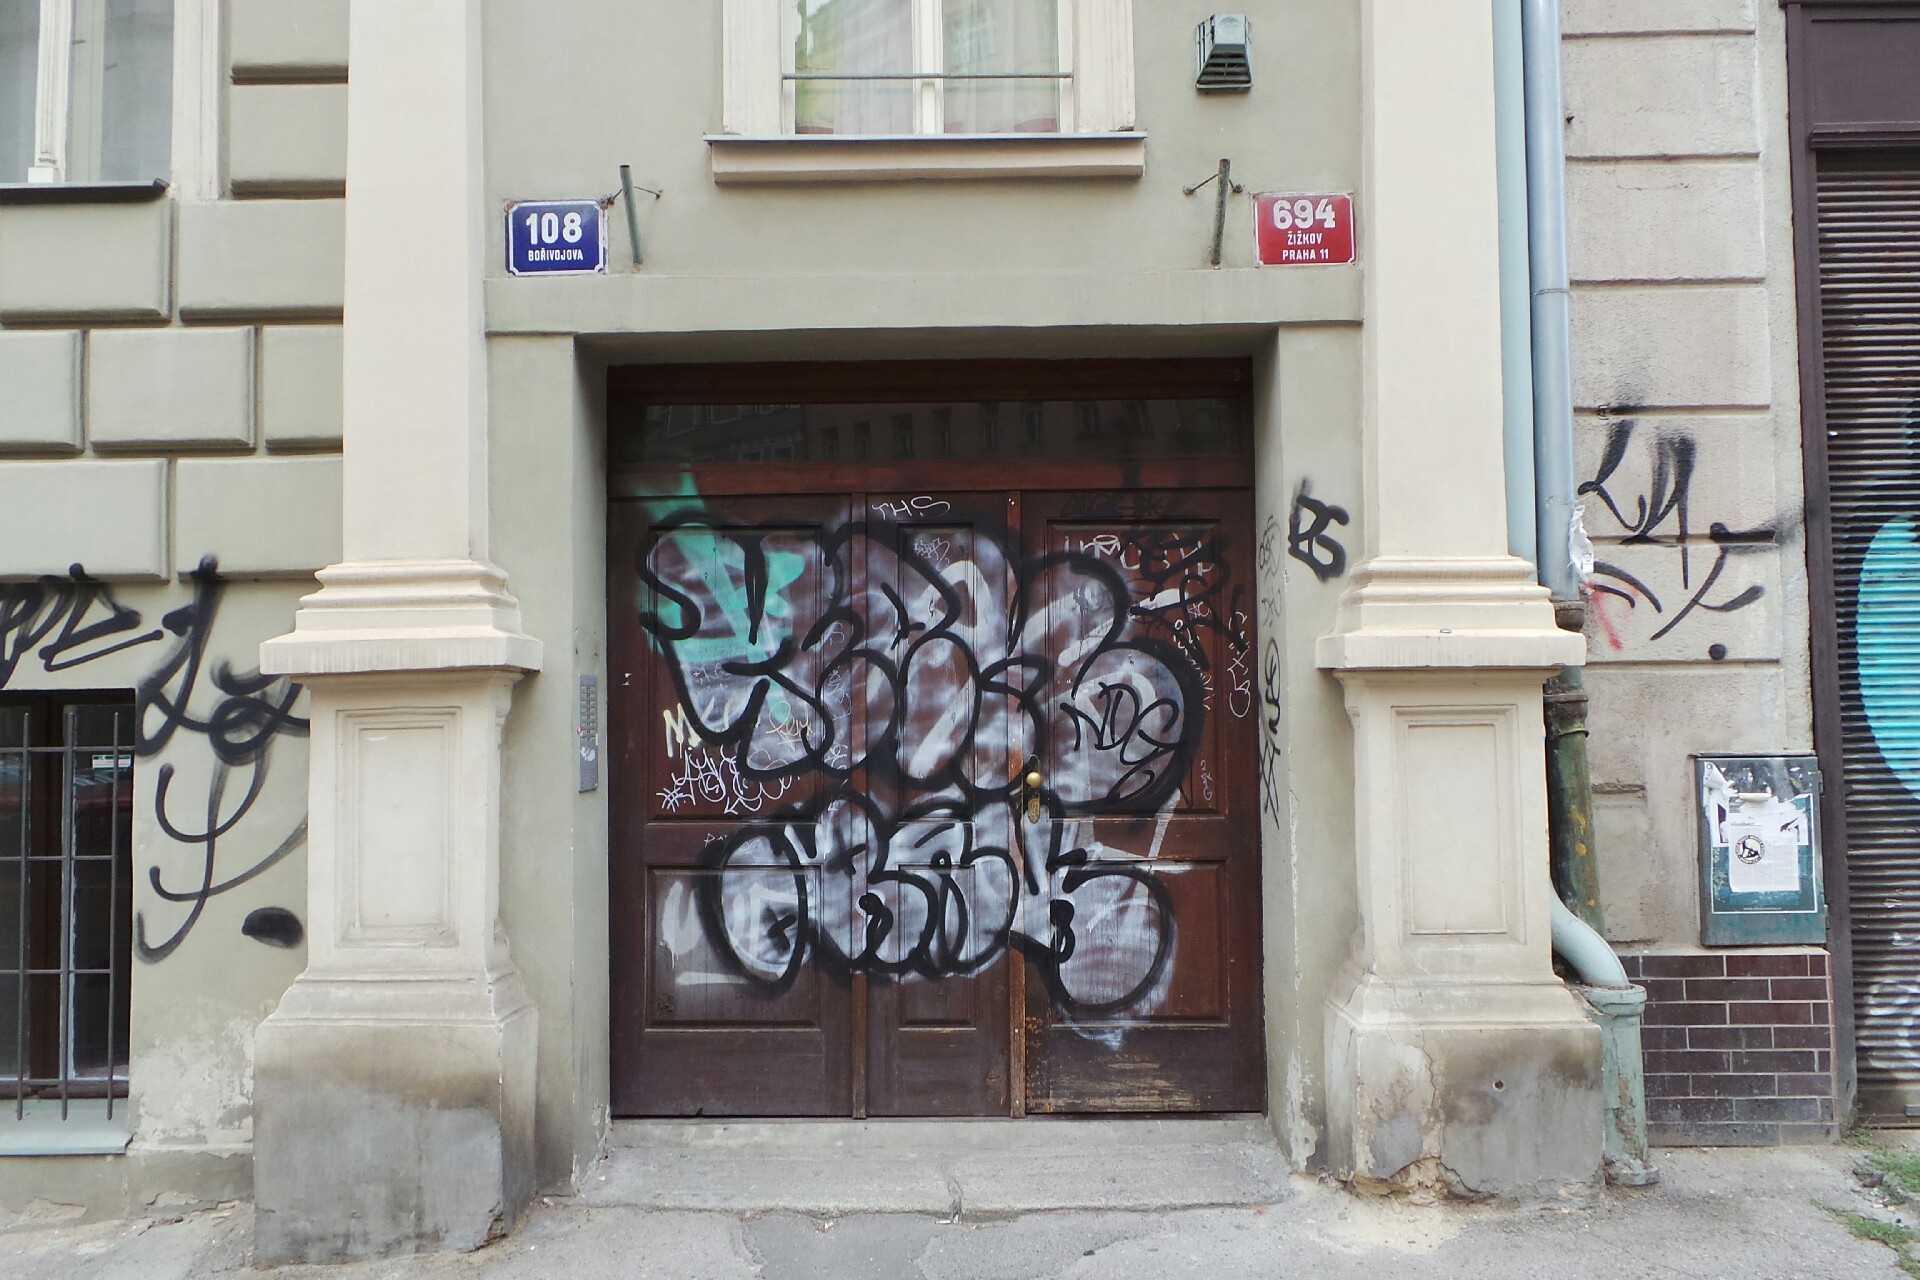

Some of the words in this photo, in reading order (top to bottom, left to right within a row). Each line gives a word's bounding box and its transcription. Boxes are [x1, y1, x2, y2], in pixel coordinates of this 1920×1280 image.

[1273, 198, 1336, 230] 694
[525, 212, 583, 245] 108
[1287, 231, 1323, 246] ŽIŽKOV
[528, 247, 584, 262] BOŘIVOJOVA
[1282, 249, 1317, 261] PRAHA
[1319, 248, 1329, 260] 11
